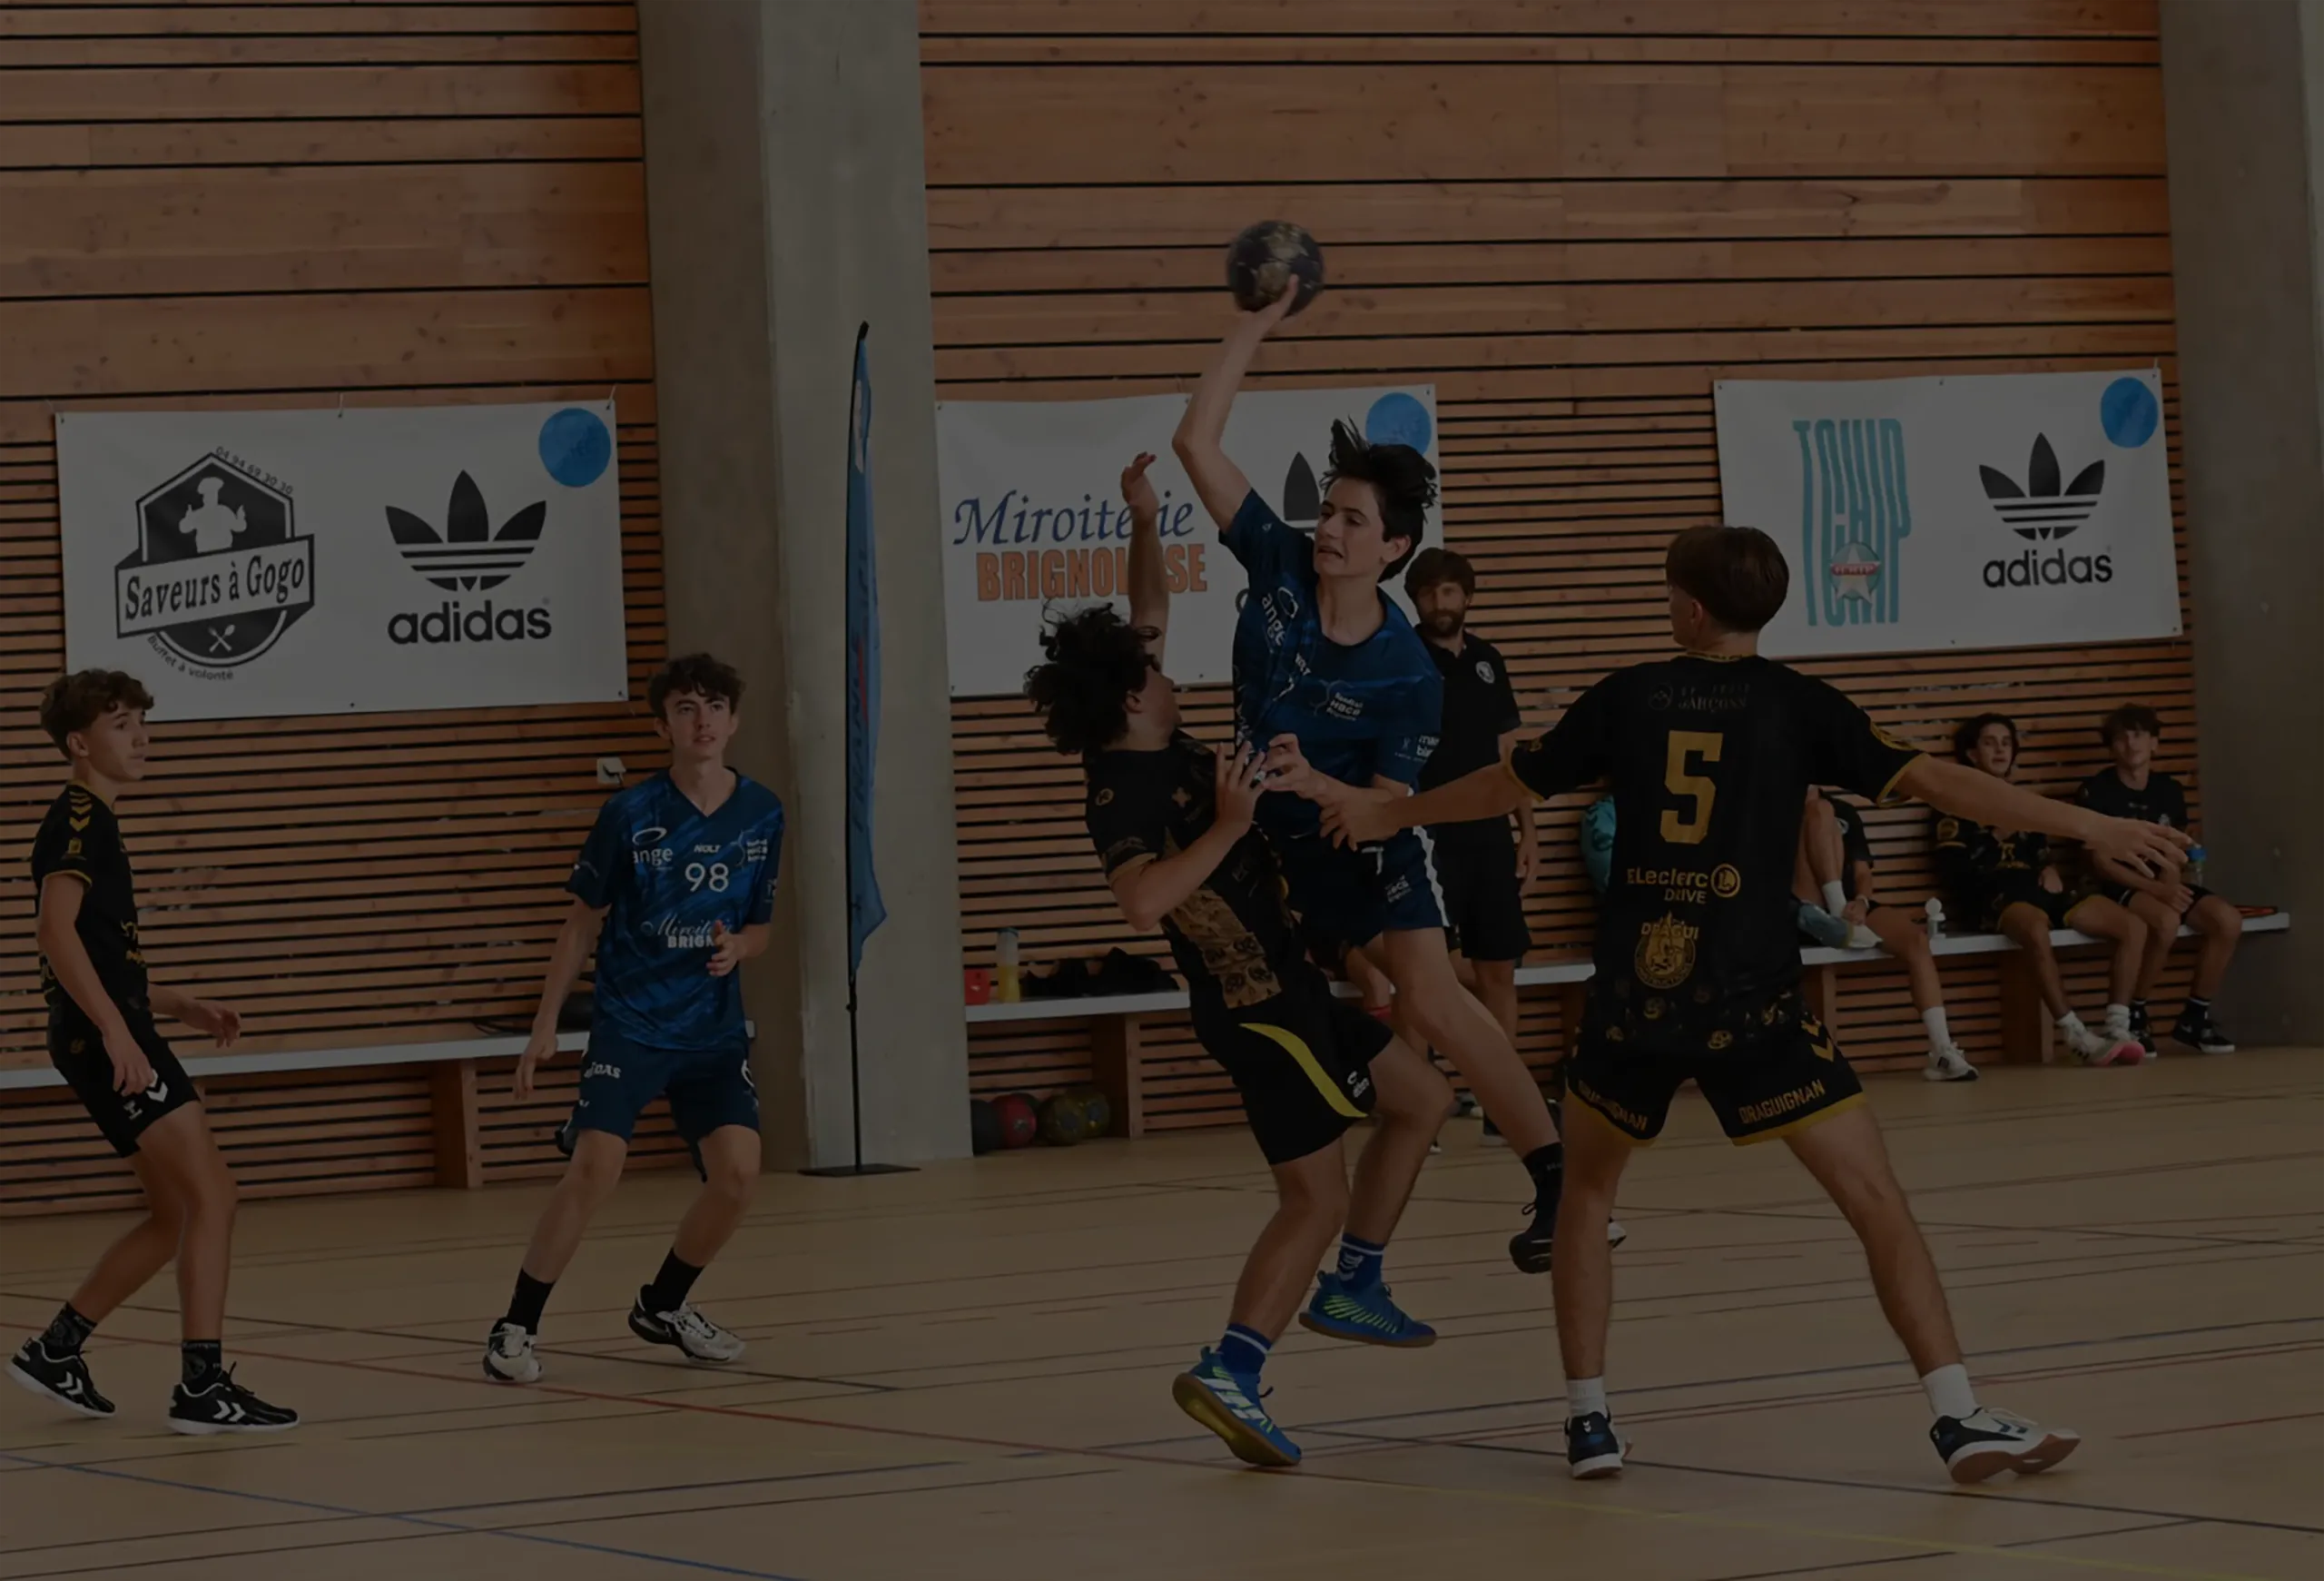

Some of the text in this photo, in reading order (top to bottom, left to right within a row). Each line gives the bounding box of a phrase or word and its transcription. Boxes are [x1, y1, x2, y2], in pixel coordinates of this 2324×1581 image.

[952, 489, 1195, 546] Miroiteie
[125, 555, 305, 620] Saveurs à Gogo
[976, 543, 1207, 602] BRIGNOLSE
[1983, 548, 2112, 588] adidas
[388, 599, 552, 645] adidas
[147, 635, 177, 667] Buffet
[189, 669, 233, 681] volonté
[1659, 729, 1724, 845] 5
[684, 862, 730, 894] 98
[1738, 1078, 1827, 1124] DRAGUIGNAN
